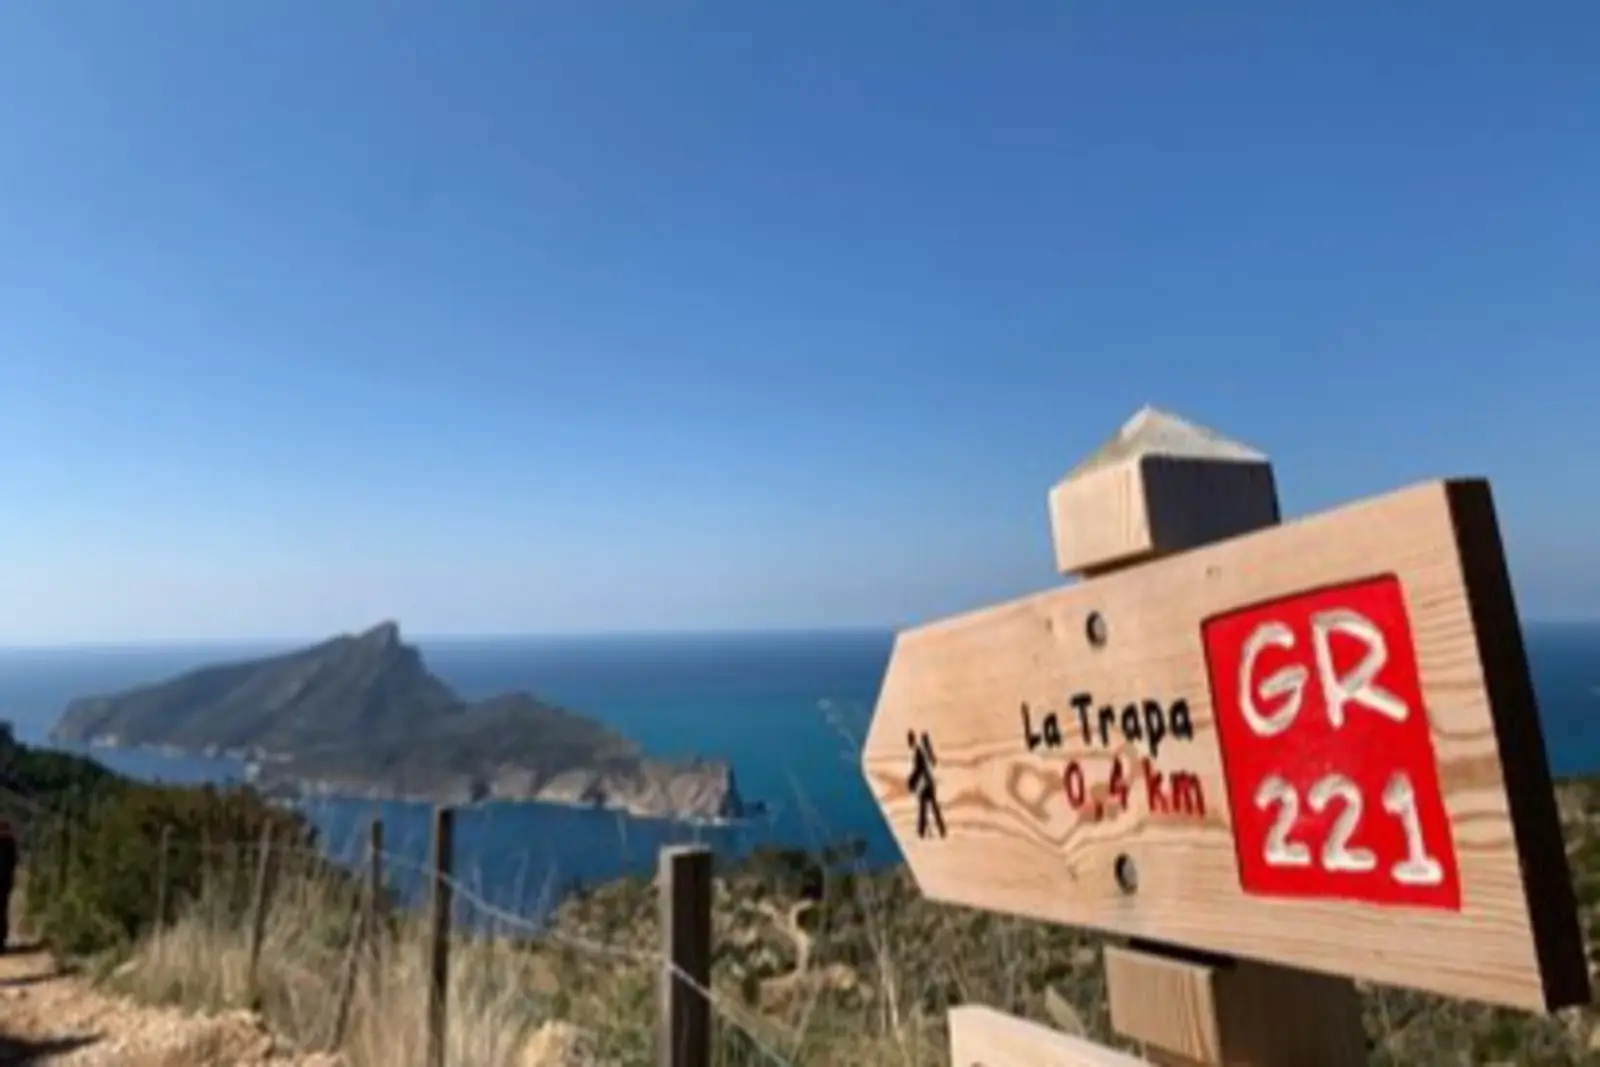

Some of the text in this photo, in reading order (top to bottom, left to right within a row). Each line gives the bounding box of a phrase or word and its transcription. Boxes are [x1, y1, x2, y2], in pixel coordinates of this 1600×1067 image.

[1239, 609, 1408, 736] GR
[1021, 693, 1193, 757] La Trapa
[1141, 755, 1206, 822] km
[1255, 771, 1443, 884] 221
